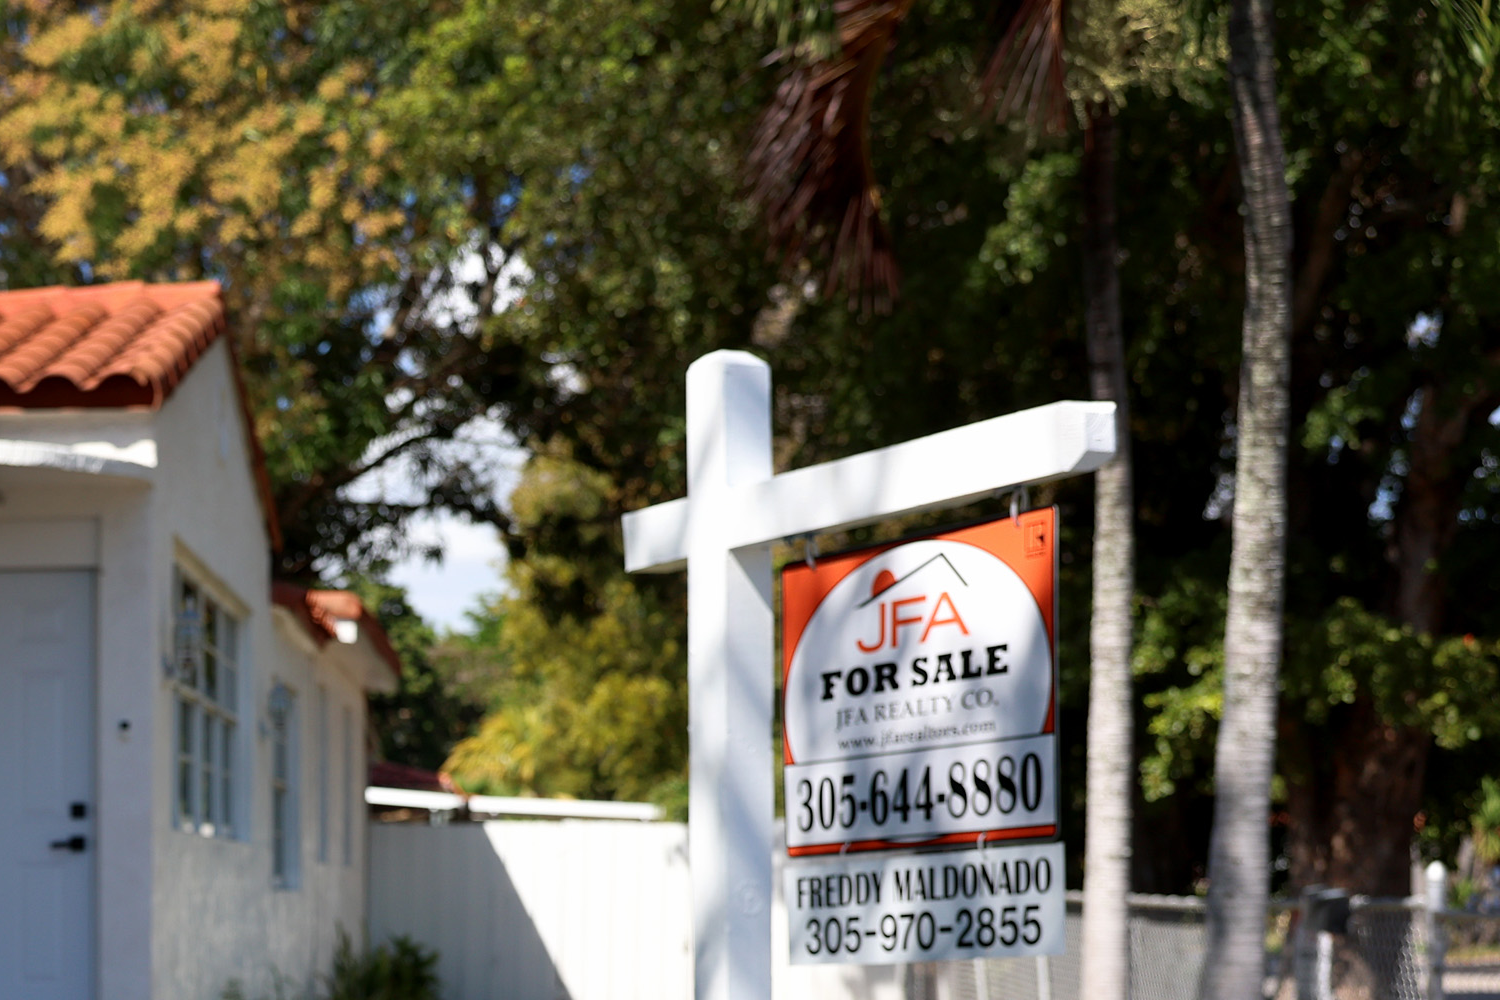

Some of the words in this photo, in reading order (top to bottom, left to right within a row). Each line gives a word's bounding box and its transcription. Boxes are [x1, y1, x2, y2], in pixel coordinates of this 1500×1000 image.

[856, 592, 971, 654] JFA
[821, 661, 900, 701] FOR
[911, 644, 1009, 687] SALE
[835, 708, 869, 731] JFA
[873, 695, 956, 723] REALTY
[960, 686, 1000, 711] CO.
[798, 751, 1044, 833] 305-644-8880
[797, 872, 883, 910] FREDDY
[895, 856, 1052, 901] MALDONADO
[805, 905, 1042, 955] 305-970-2855
